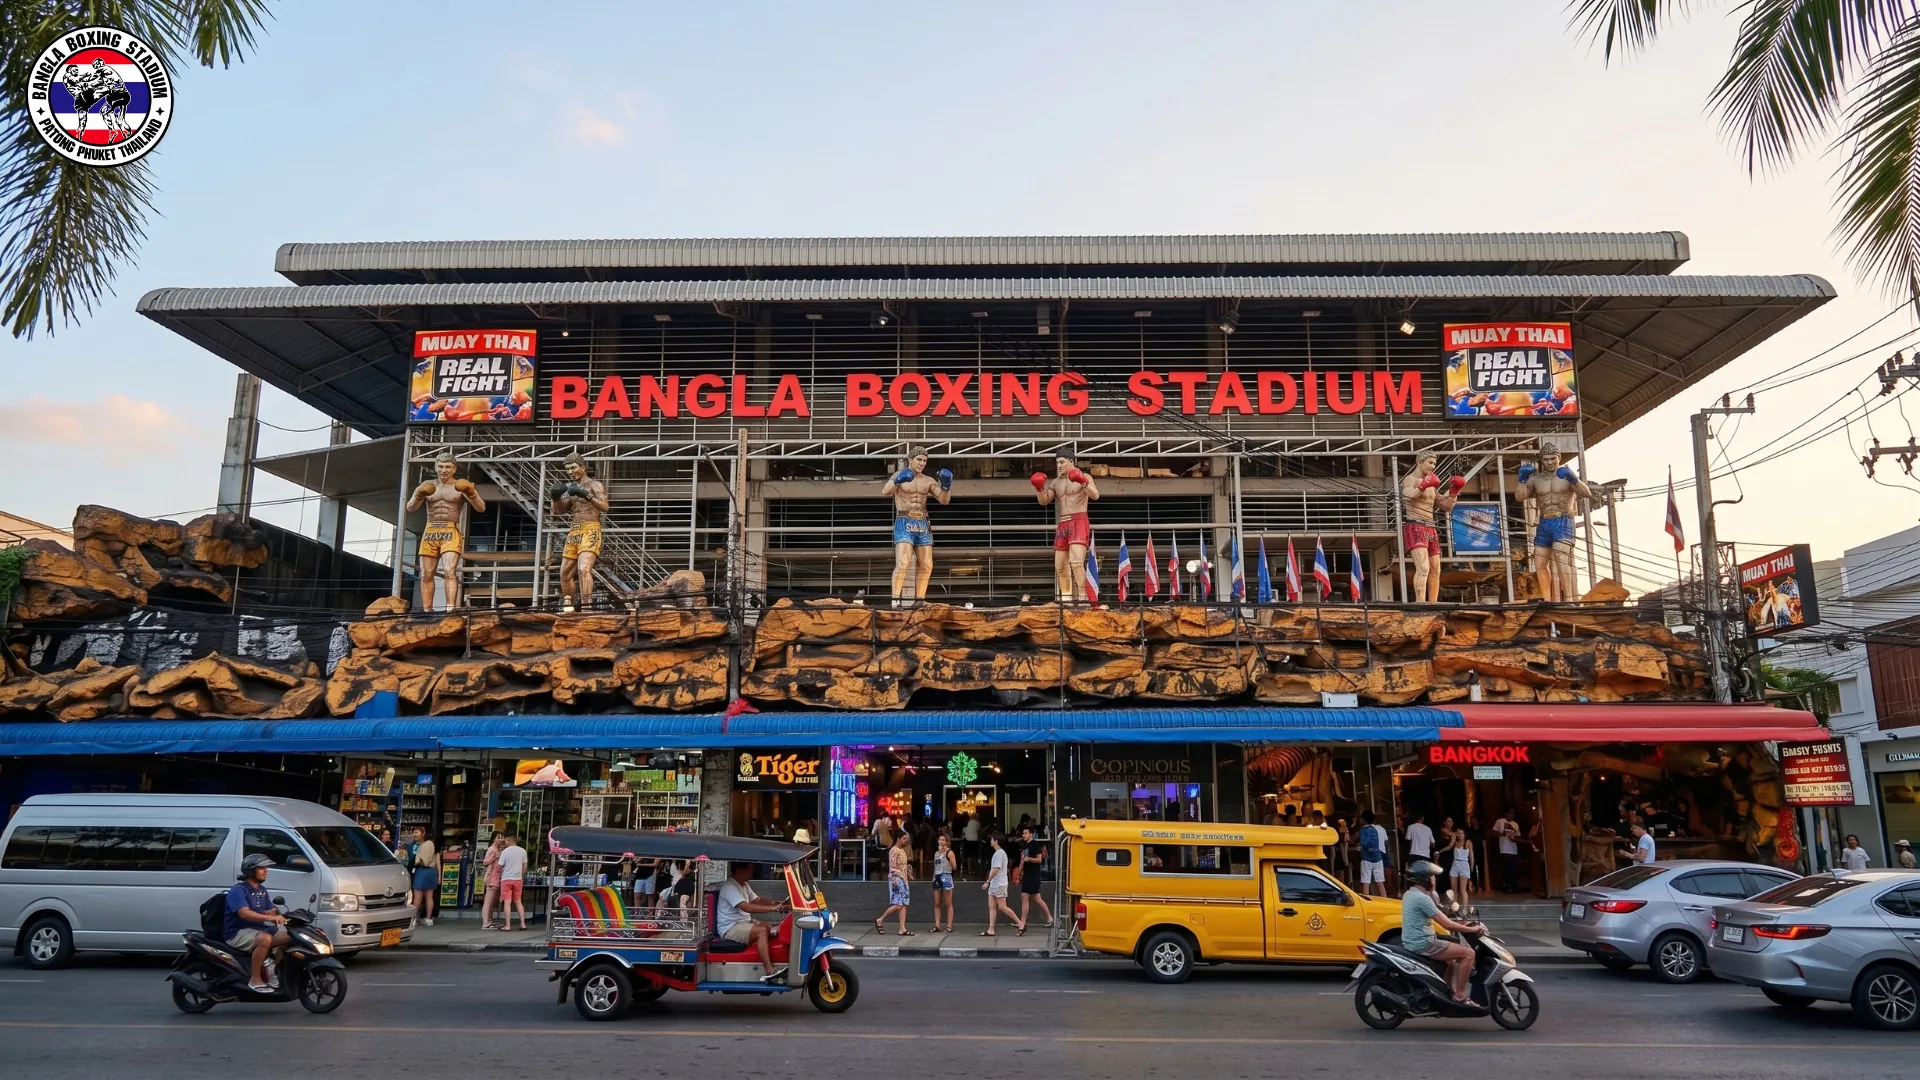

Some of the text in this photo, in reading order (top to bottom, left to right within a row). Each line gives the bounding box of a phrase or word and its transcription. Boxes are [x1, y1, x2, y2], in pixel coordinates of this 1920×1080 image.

[421, 334, 530, 351] MUAY THAI
[1451, 327, 1565, 345] MUAY THAI
[439, 357, 505, 376] REAL
[1474, 351, 1544, 370] REAL
[439, 376, 508, 393] FIGHT
[1477, 369, 1547, 387] FIGHT
[550, 370, 1424, 419] BANGLA BOXING STADIUM
[1742, 553, 1794, 583] MUAY THAI
[1430, 746, 1530, 763] BANGKOK
[753, 753, 820, 785] Tiger
